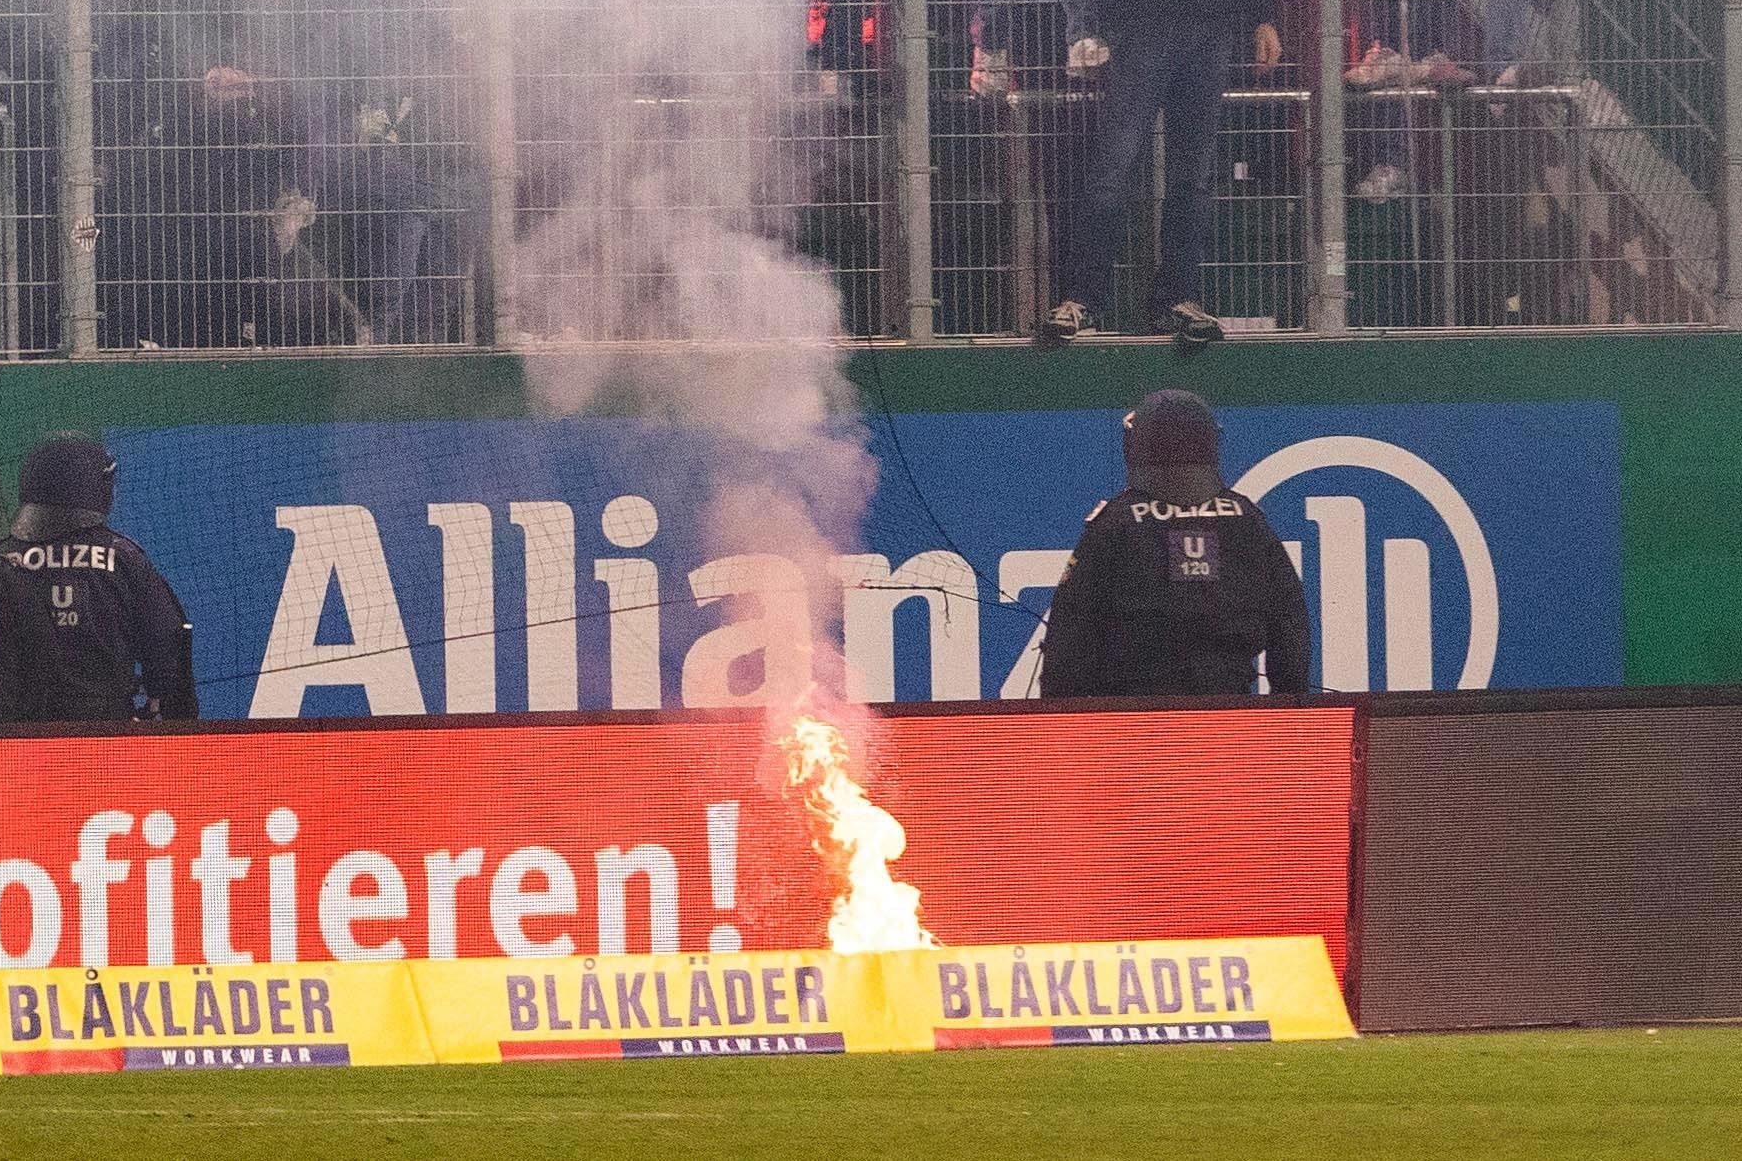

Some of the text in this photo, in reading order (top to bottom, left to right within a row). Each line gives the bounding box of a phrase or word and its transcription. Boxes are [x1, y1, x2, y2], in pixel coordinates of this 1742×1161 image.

[1183, 537, 1205, 559] U
[1181, 562, 1209, 576] 120
[52, 585, 73, 608] U
[52, 611, 79, 627] 20
[938, 944, 1255, 1019] BLÅKLÄDER
[8, 968, 336, 1041] BLÅKLÄDER
[507, 956, 829, 1031] BLÅKLÄDER
[160, 1047, 313, 1066] WORKWEAR
[656, 1036, 809, 1055] WORKWEAR
